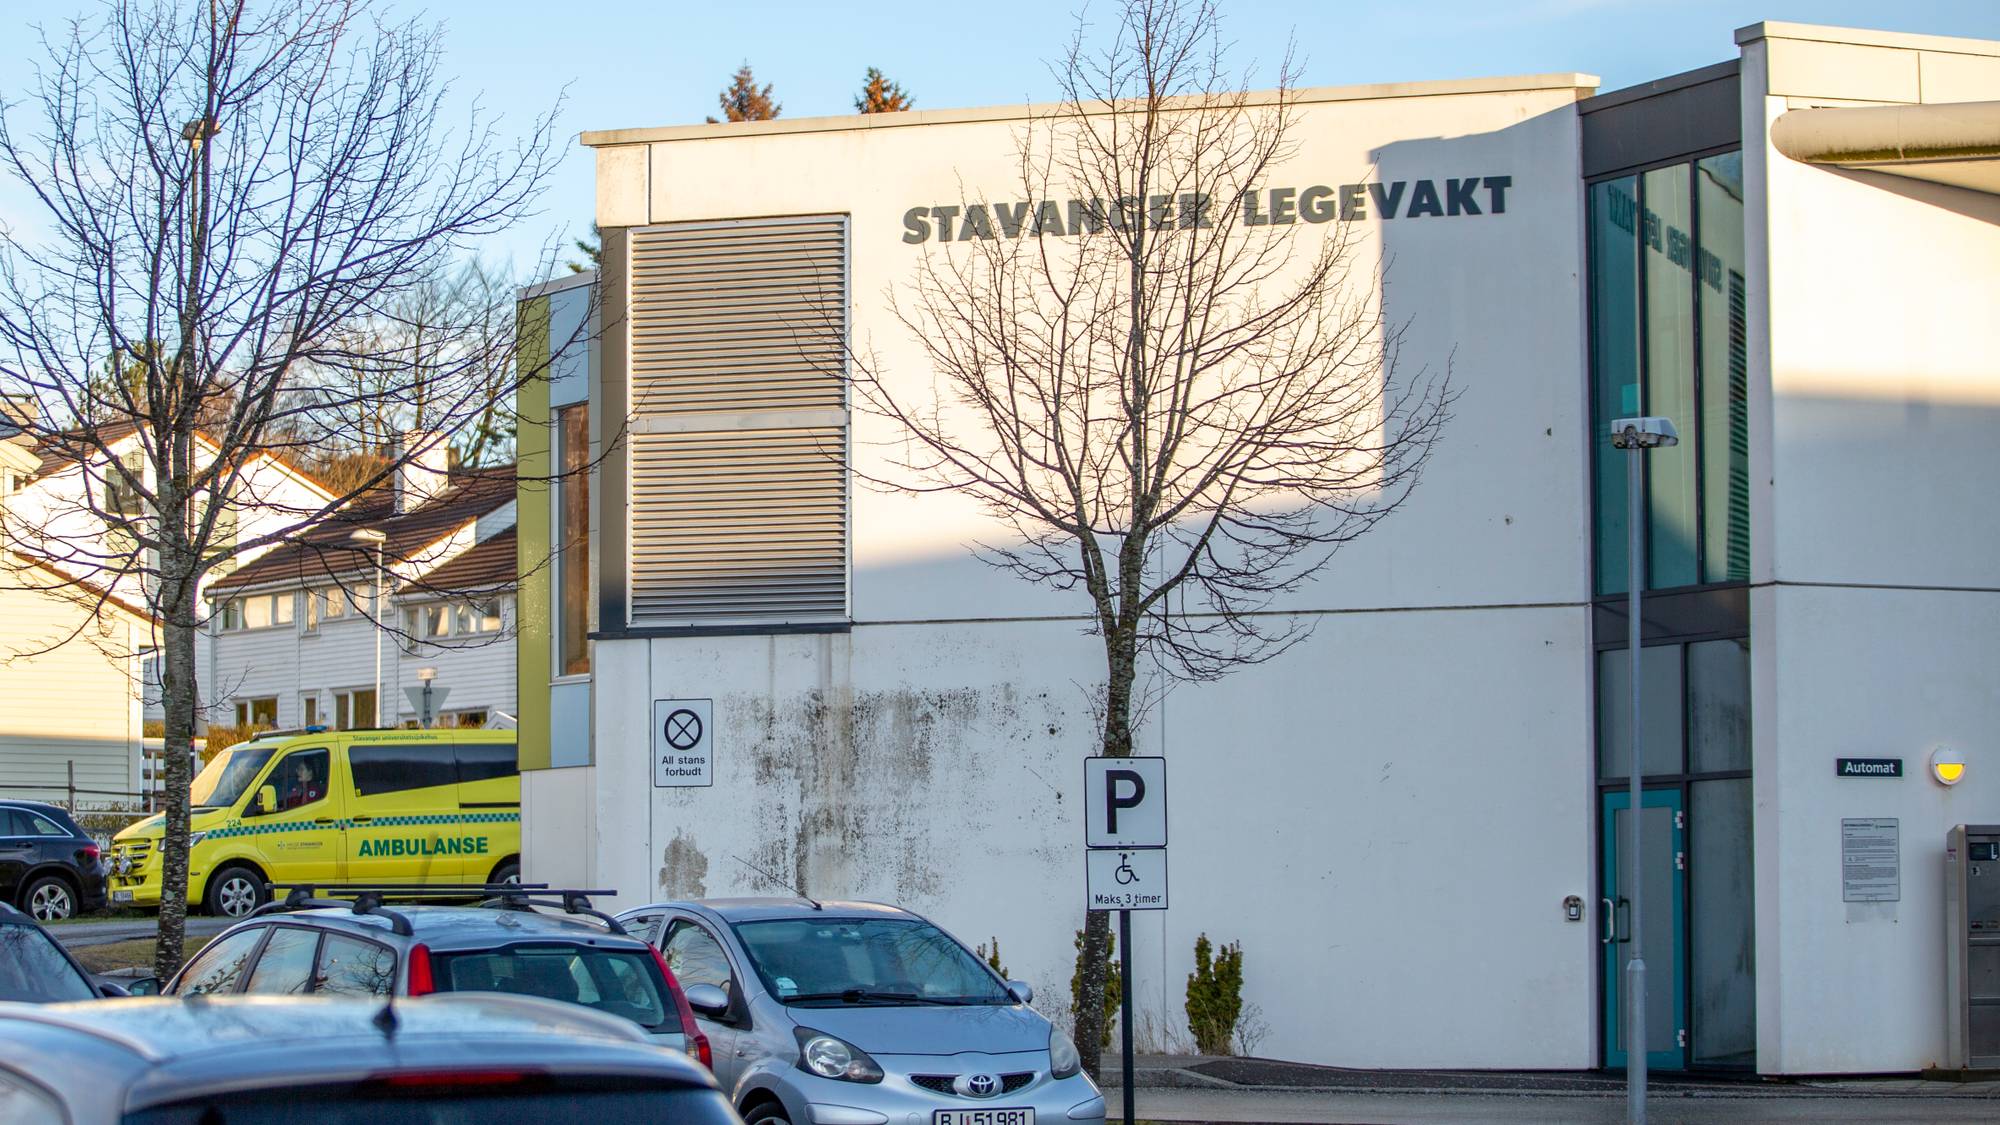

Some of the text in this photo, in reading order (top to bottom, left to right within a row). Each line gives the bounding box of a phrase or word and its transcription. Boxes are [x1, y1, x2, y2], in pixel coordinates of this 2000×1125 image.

[902, 175, 1512, 245] STAVANGER LEGEVAKT
[662, 756, 705, 764] All stans
[665, 767, 702, 776] forbudt
[1845, 762, 1895, 774] Automat
[1106, 770, 1145, 834] P
[359, 837, 488, 856] AMBULANSE
[1095, 893, 1161, 904] Maks 3 timer
[974, 1111, 1025, 1125] 51981
